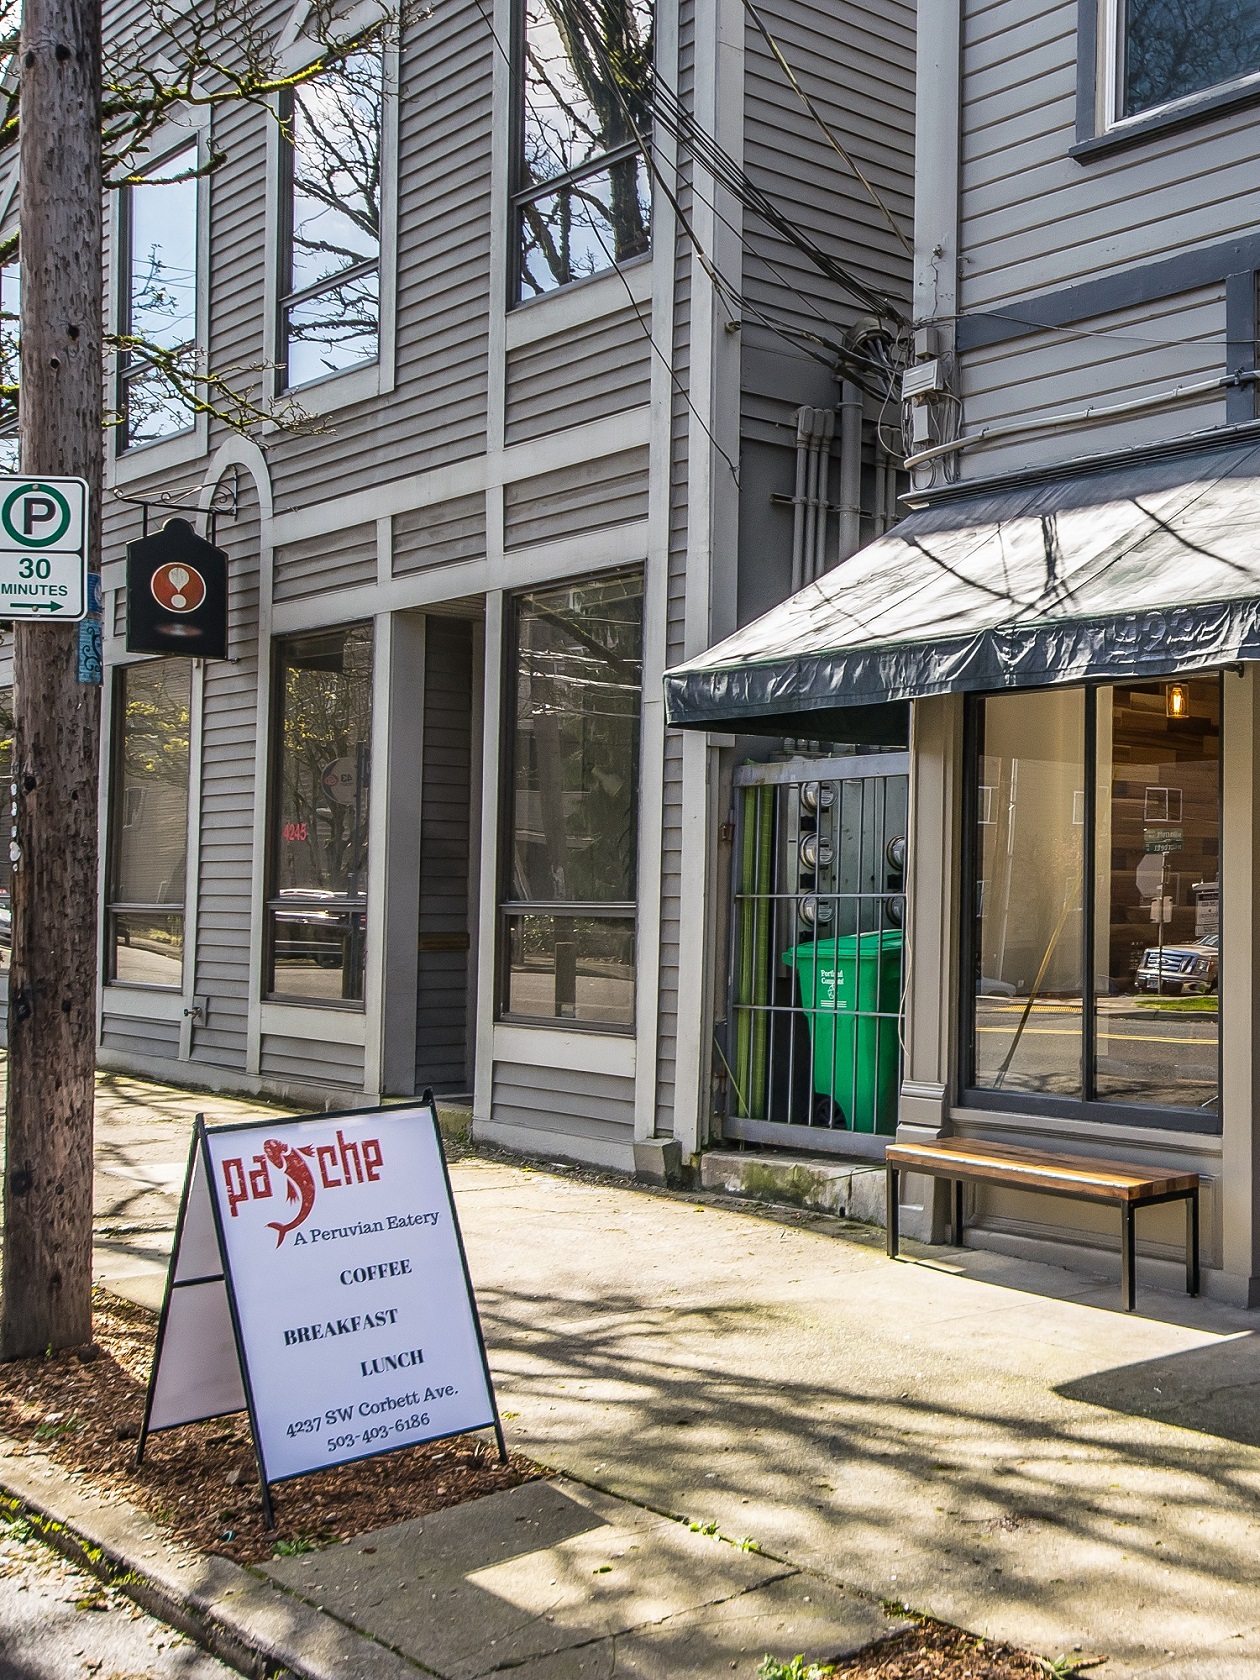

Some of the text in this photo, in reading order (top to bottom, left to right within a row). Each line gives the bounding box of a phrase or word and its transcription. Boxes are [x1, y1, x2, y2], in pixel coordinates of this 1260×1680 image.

[24, 497, 56, 535] P
[18, 557, 52, 580] 30
[1, 583, 68, 597] MINUTES
[283, 823, 308, 841] 4245
[293, 1211, 440, 1246] A Peruvian Eatery
[340, 1259, 413, 1286] COFFEE
[283, 1308, 399, 1347] BREAKFAST
[360, 1348, 425, 1378] LUNCH
[286, 1385, 459, 1438] 4237 SW Corbett Ave.
[326, 1412, 431, 1452] 503-403-6186
